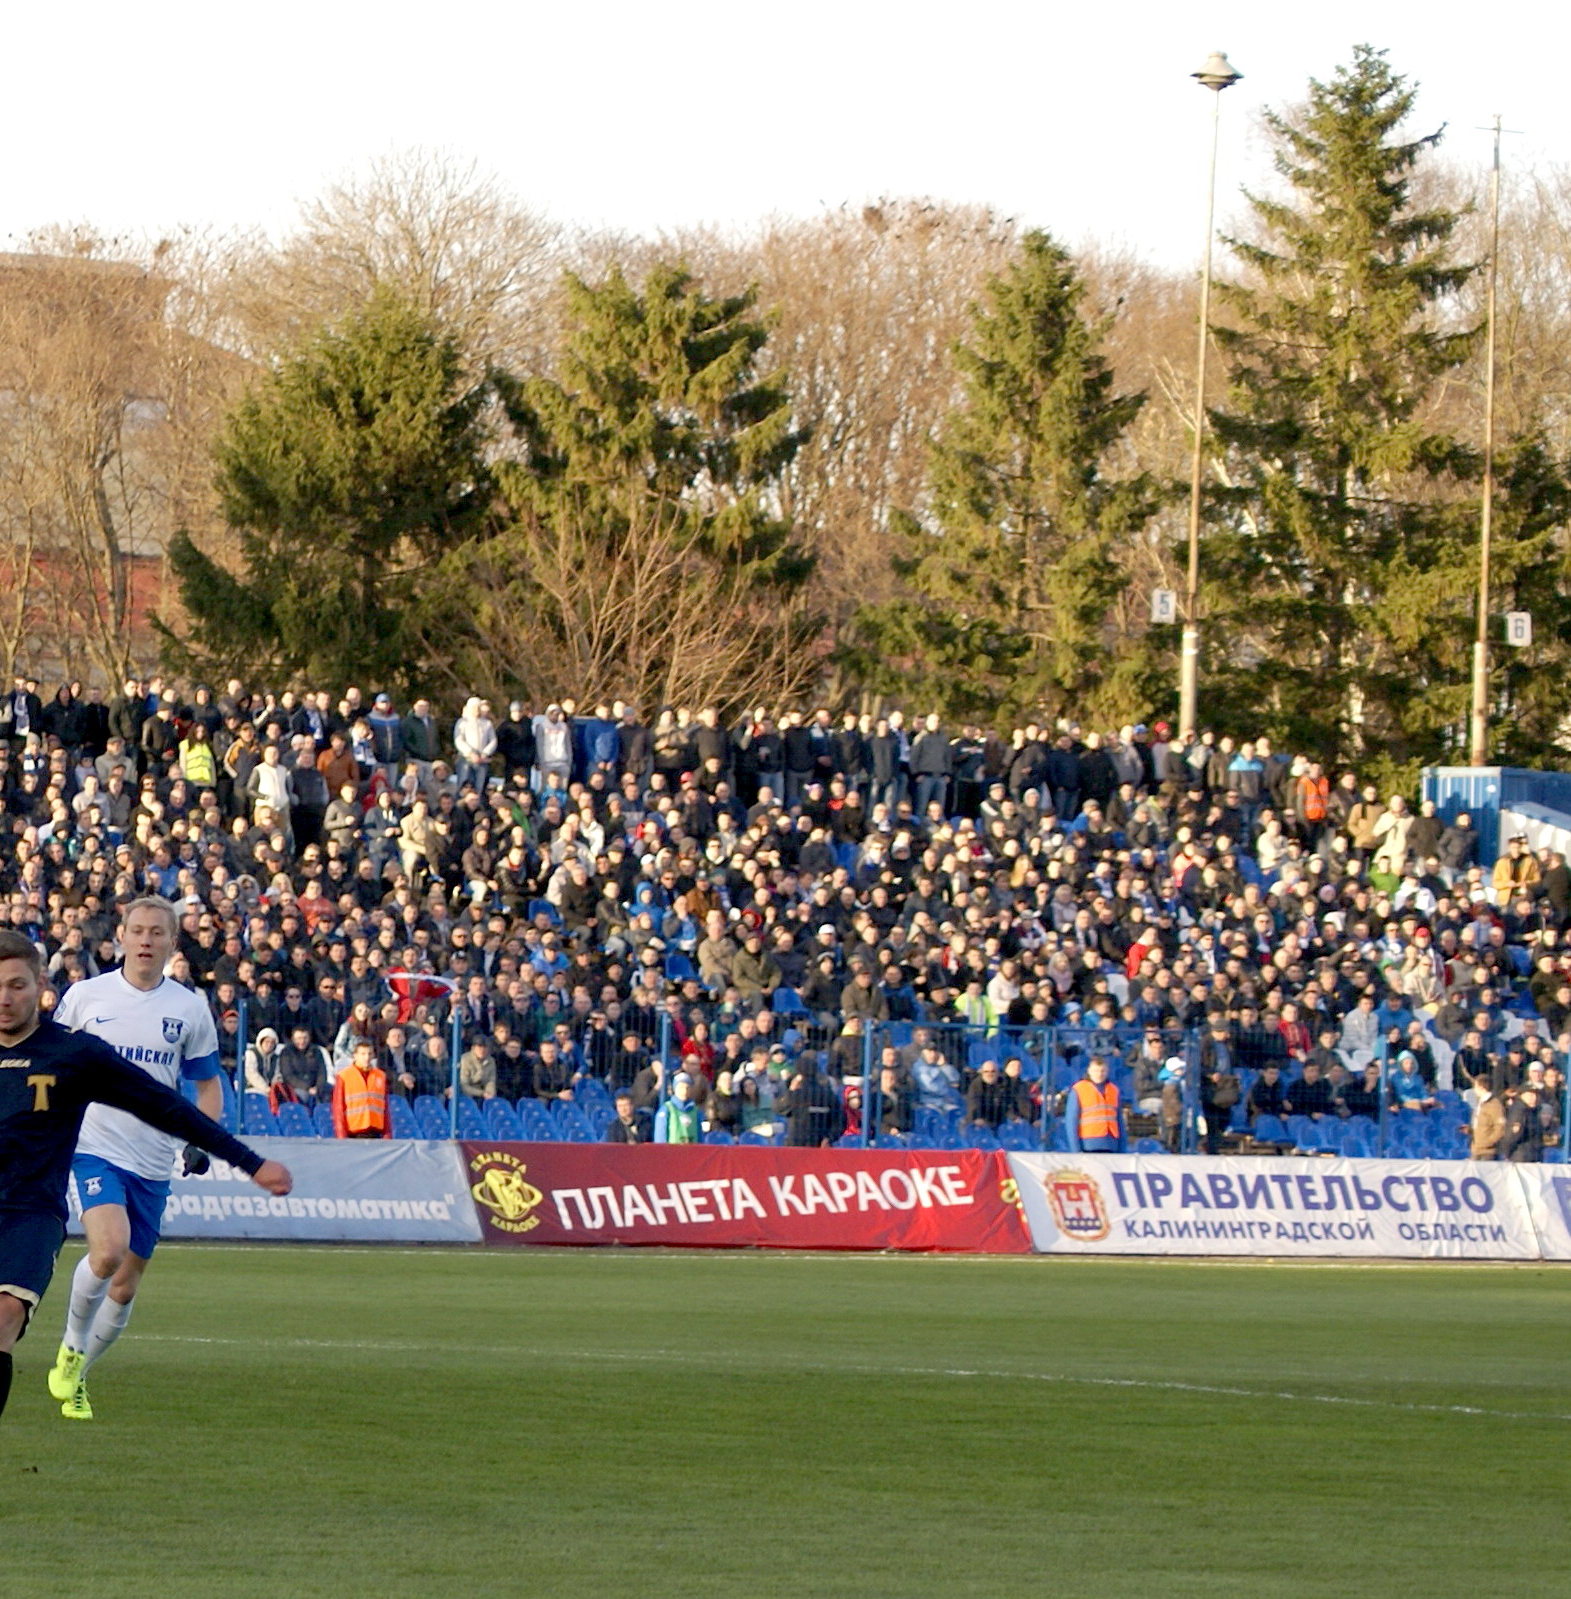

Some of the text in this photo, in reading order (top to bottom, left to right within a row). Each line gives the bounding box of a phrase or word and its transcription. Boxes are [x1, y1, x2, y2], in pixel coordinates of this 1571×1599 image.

[1160, 594, 1170, 615] 5
[1515, 618, 1524, 639] 6
[552, 1178, 767, 1230] ПЛАНЕТА
[769, 1166, 975, 1216] КАРАОКЕ
[1111, 1172, 1495, 1214] ПРАВИТЕЛЬСТВО
[1125, 1218, 1508, 1243] КАЛИНИНГРАДСКОЙ ОБЛАСТИ
